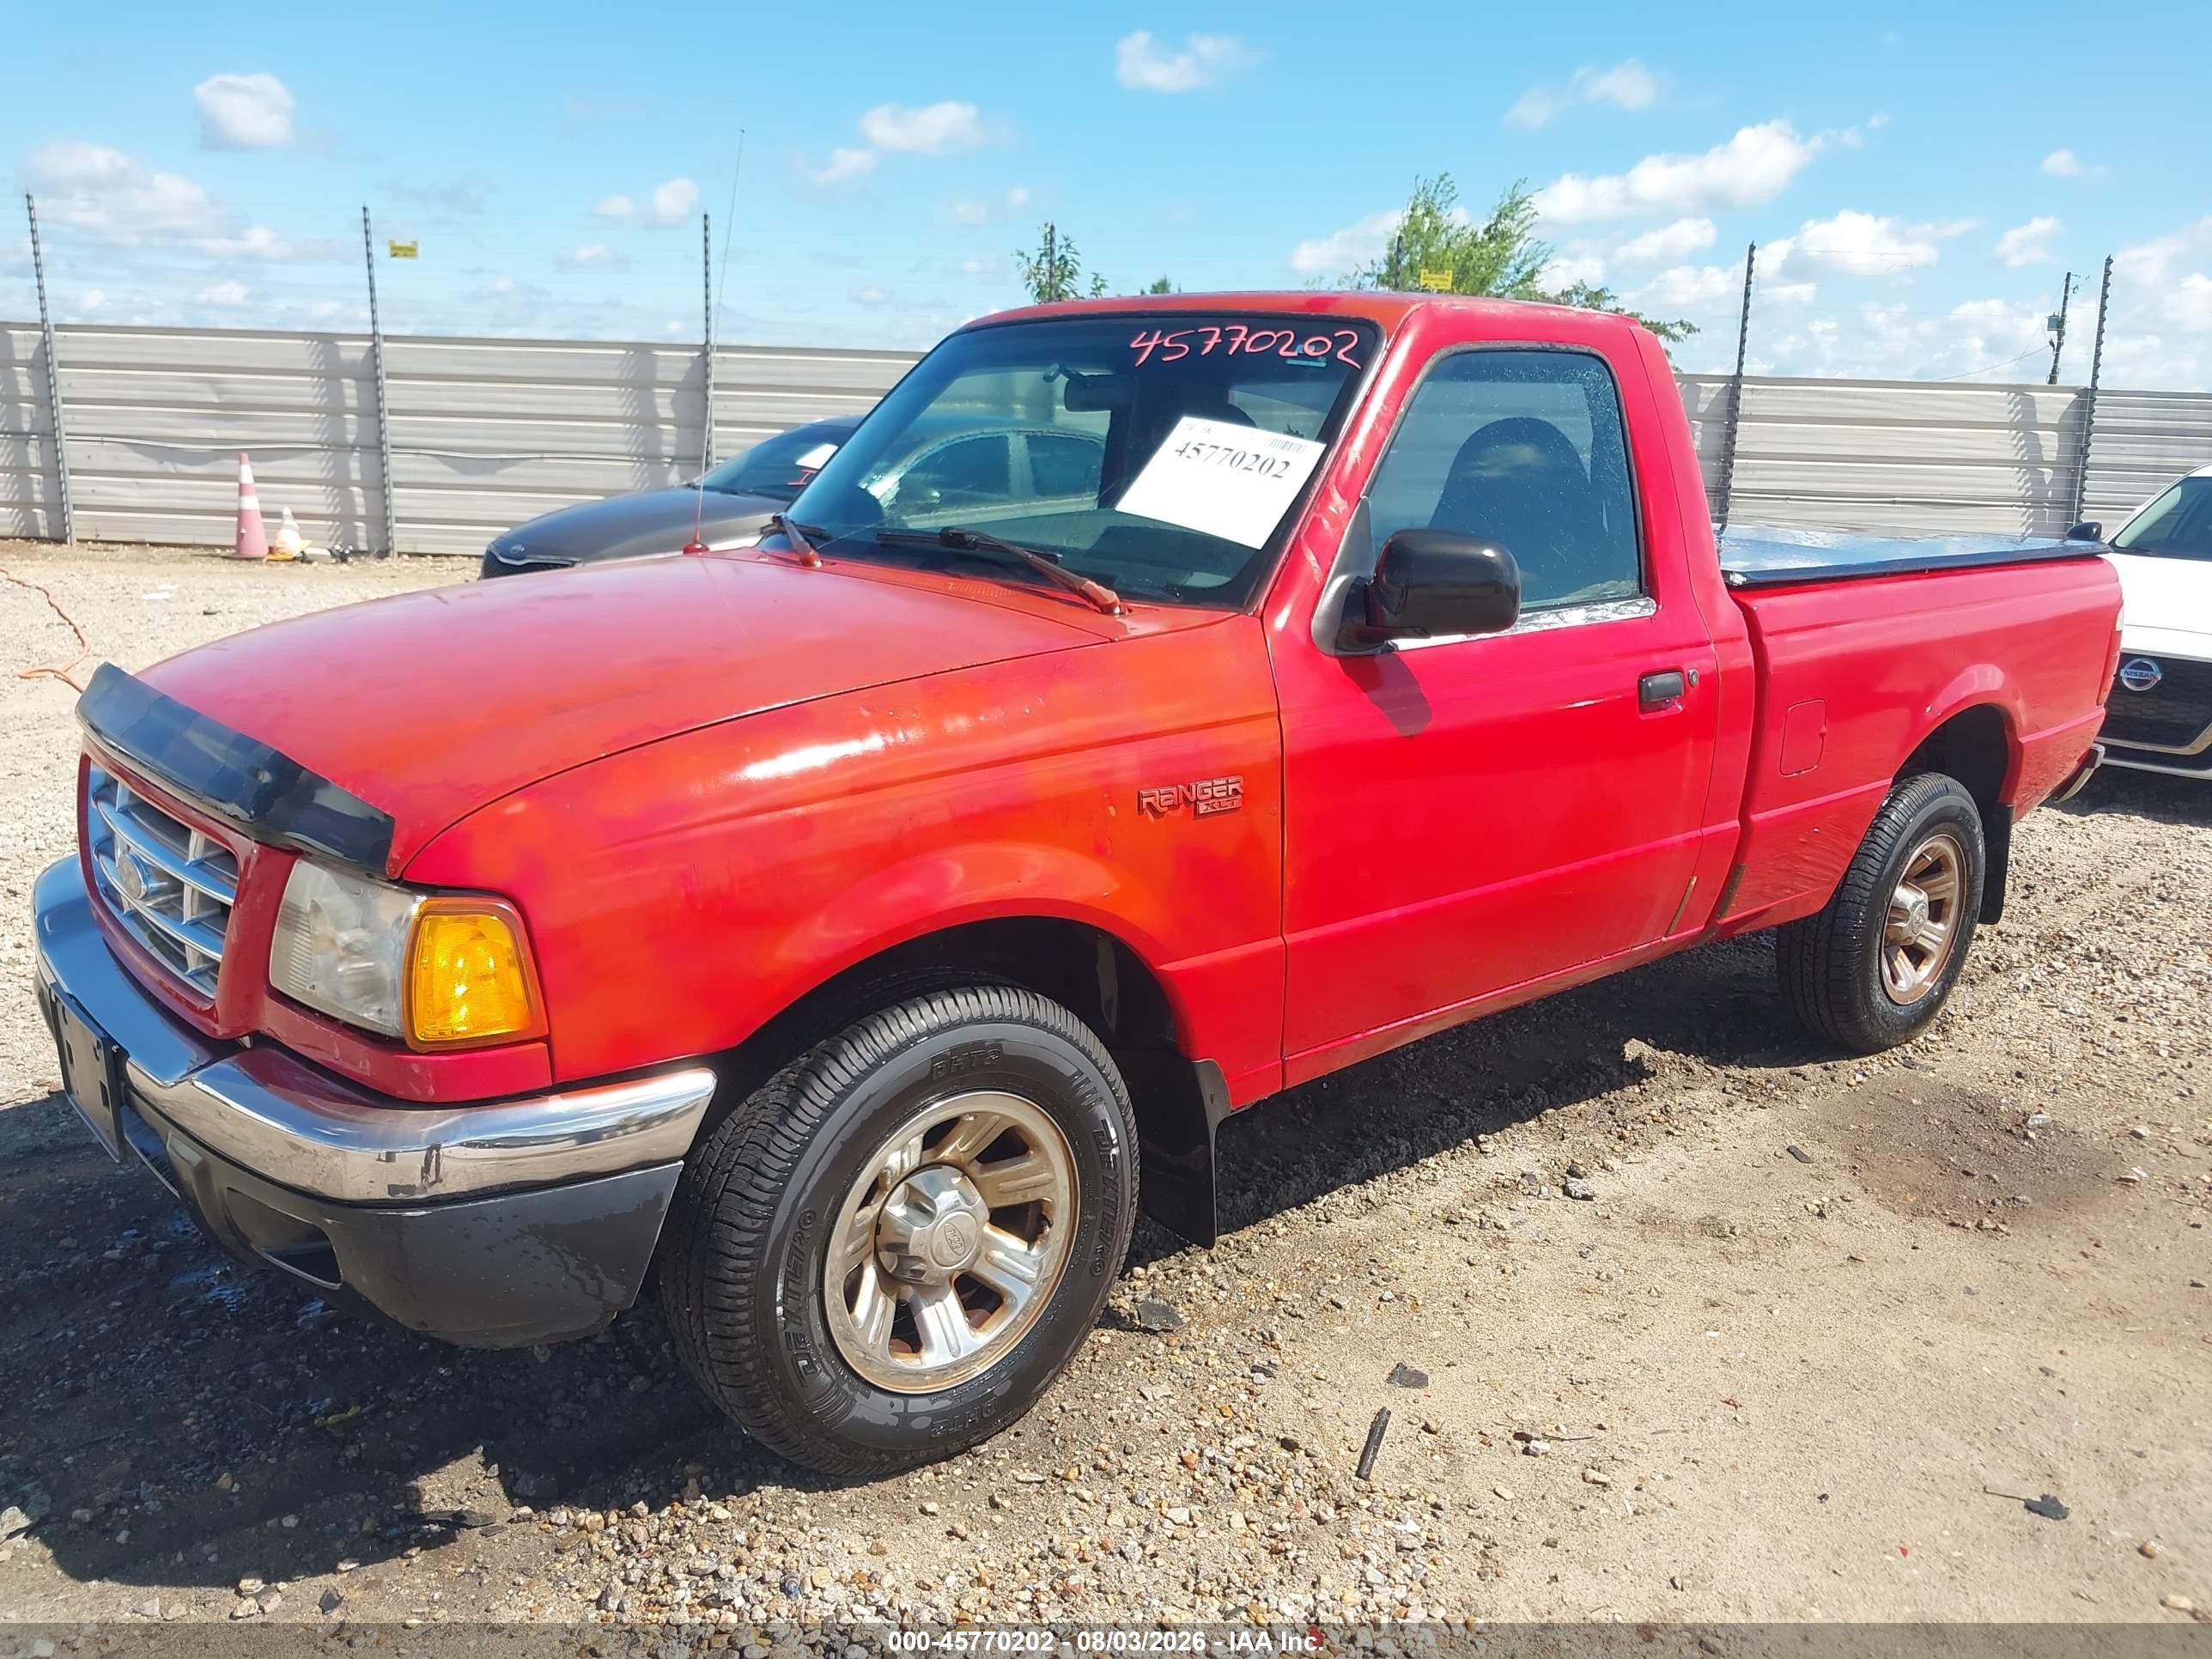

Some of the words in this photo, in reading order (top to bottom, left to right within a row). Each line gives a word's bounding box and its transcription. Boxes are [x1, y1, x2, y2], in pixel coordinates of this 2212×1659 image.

[1130, 325, 1362, 369] 45770202
[1175, 441, 1291, 478] 45770202
[2124, 671, 2157, 679] NISSAN
[1137, 775, 1244, 813] RANGER
[1202, 798, 1239, 812] XLT
